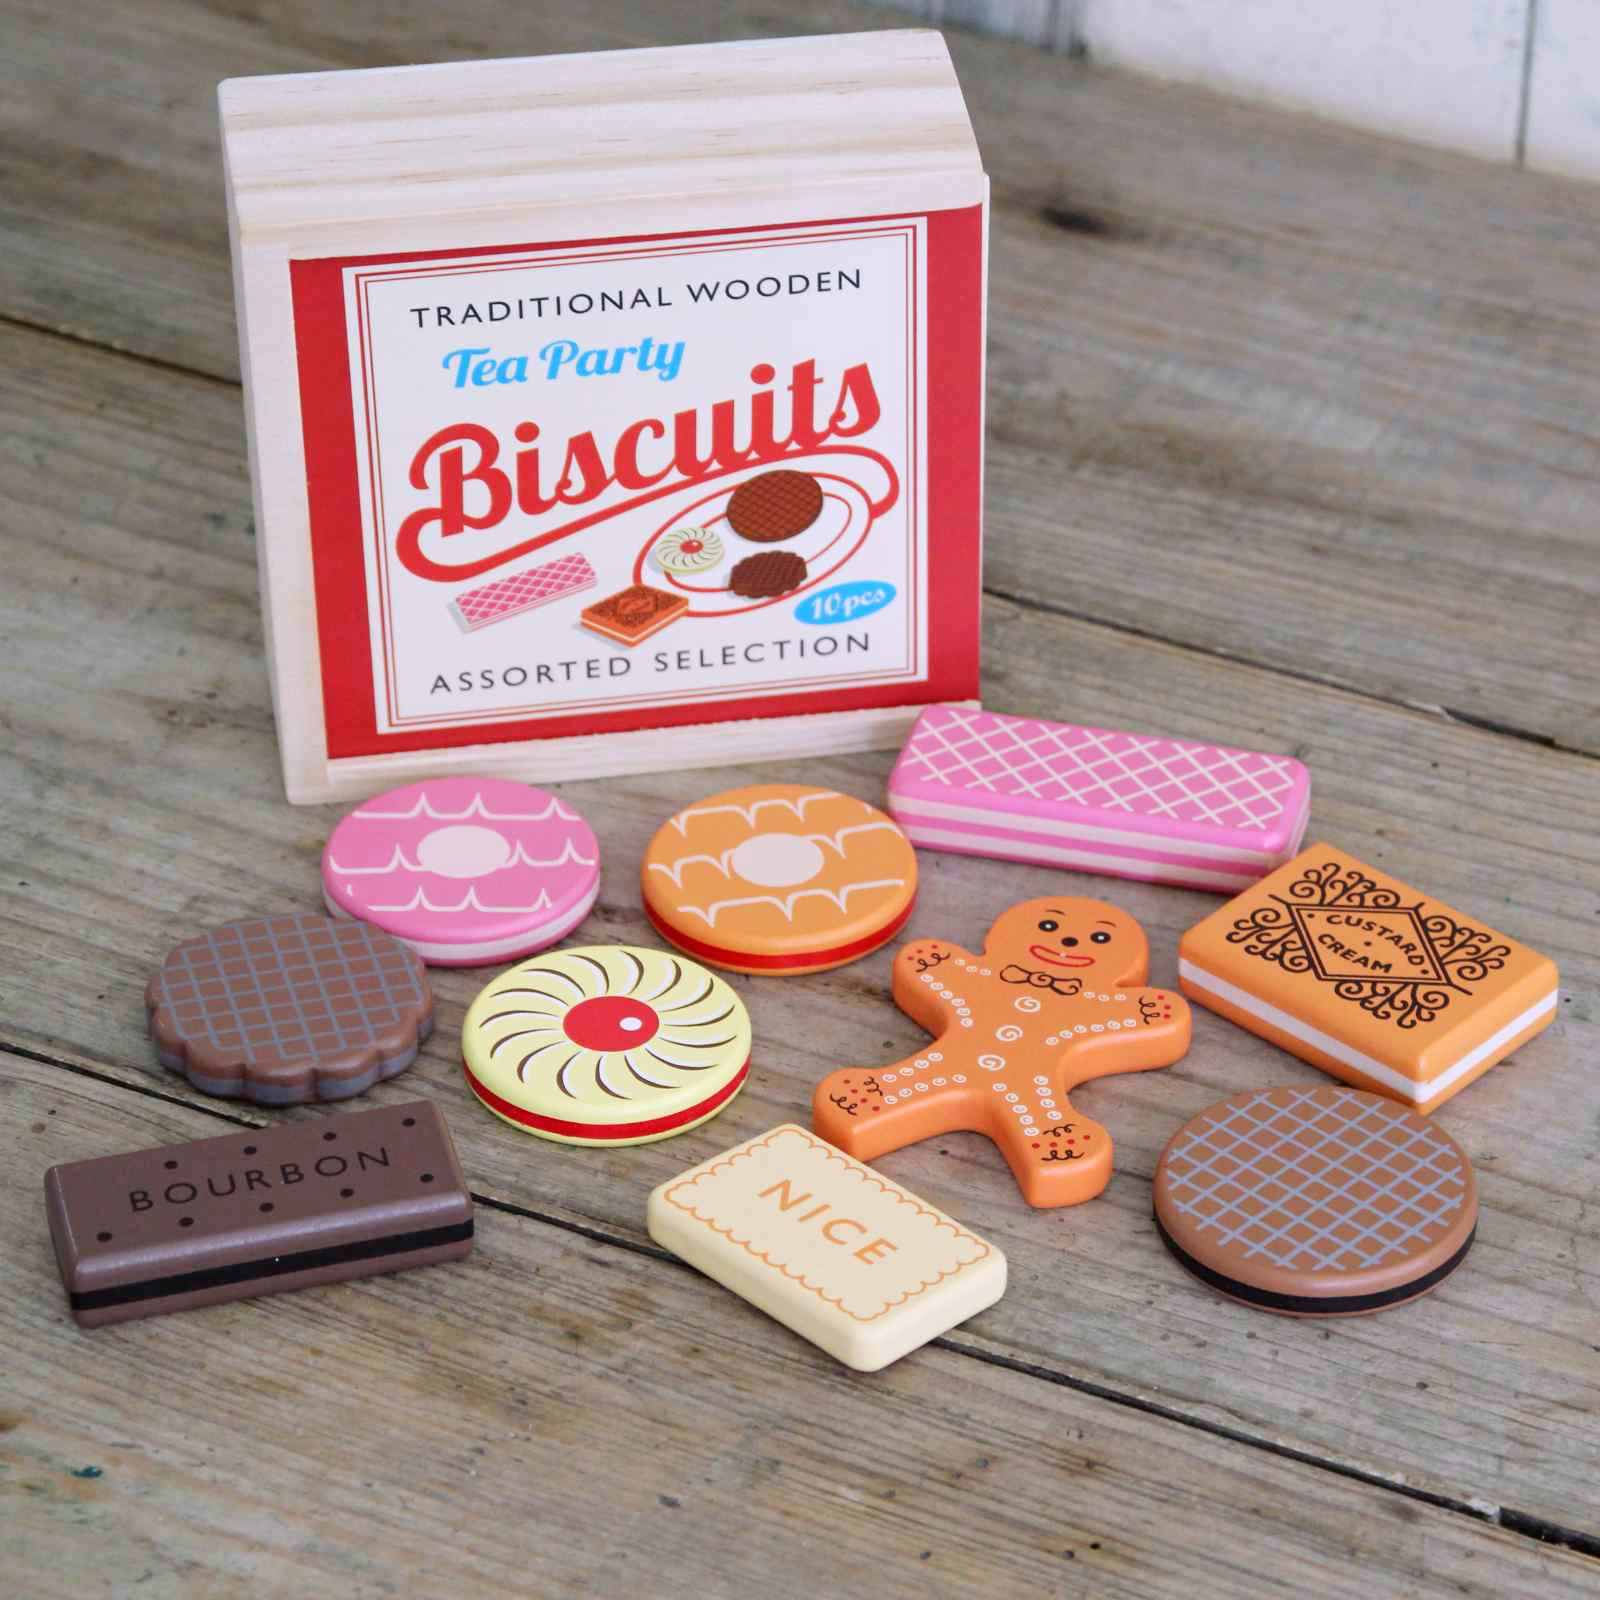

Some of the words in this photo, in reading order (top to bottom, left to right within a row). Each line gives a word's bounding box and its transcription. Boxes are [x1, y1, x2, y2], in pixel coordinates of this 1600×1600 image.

[410, 287, 673, 329] TRADITIONAL
[687, 269, 863, 303] WOODEN
[441, 344, 529, 388] Tea
[539, 337, 687, 382] Party
[408, 358, 881, 538] Biscuits
[429, 656, 632, 695] ASSORTED
[654, 633, 870, 672] SELECTION
[1318, 933, 1393, 974] CREAM
[1326, 914, 1425, 966] CUSTARD
[128, 1146, 391, 1213] BOURBON
[757, 1178, 900, 1265] NICE
